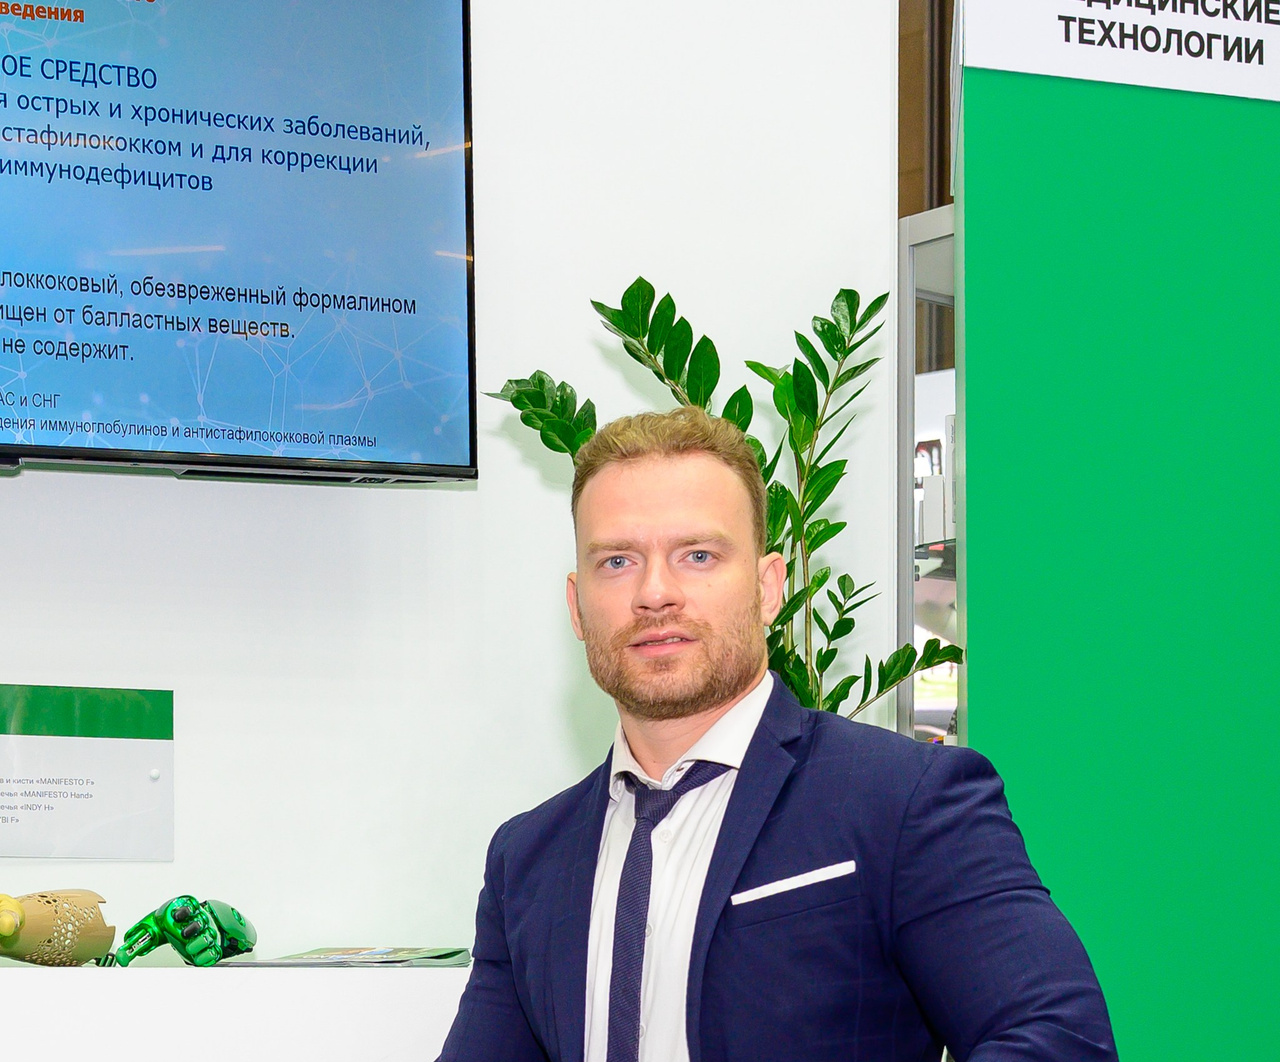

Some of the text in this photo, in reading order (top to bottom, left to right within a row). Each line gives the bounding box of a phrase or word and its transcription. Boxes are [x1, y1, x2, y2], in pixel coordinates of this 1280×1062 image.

[1057, 15, 1264, 66] ТЕХНОЛОГИИ
[40, 58, 158, 89] СРЕДСТВО
[17, 95, 101, 118] острых
[109, 103, 121, 119] и
[131, 103, 275, 132] хронических
[282, 115, 430, 151] заболеваний,
[2, 124, 181, 156] стафилококком
[191, 143, 203, 158] и
[212, 144, 252, 163] для
[261, 147, 378, 174] коррекции
[0, 159, 213, 191] иммунодефицитов
[130, 276, 286, 306] обезвреженный
[292, 287, 416, 315] формалином
[54, 309, 75, 324] от
[82, 304, 201, 332] балластных
[209, 317, 295, 340] веществ.
[3, 337, 25, 353] не
[33, 339, 134, 362] содержит.
[20, 396, 27, 407] и
[32, 392, 60, 409] СНГ
[40, 420, 167, 437] иммуноглобулинов
[172, 427, 180, 438] и
[183, 427, 325, 446] антистафилококковой
[329, 434, 377, 448] плазмы
[36, 778, 84, 786] «MANIFESTO
